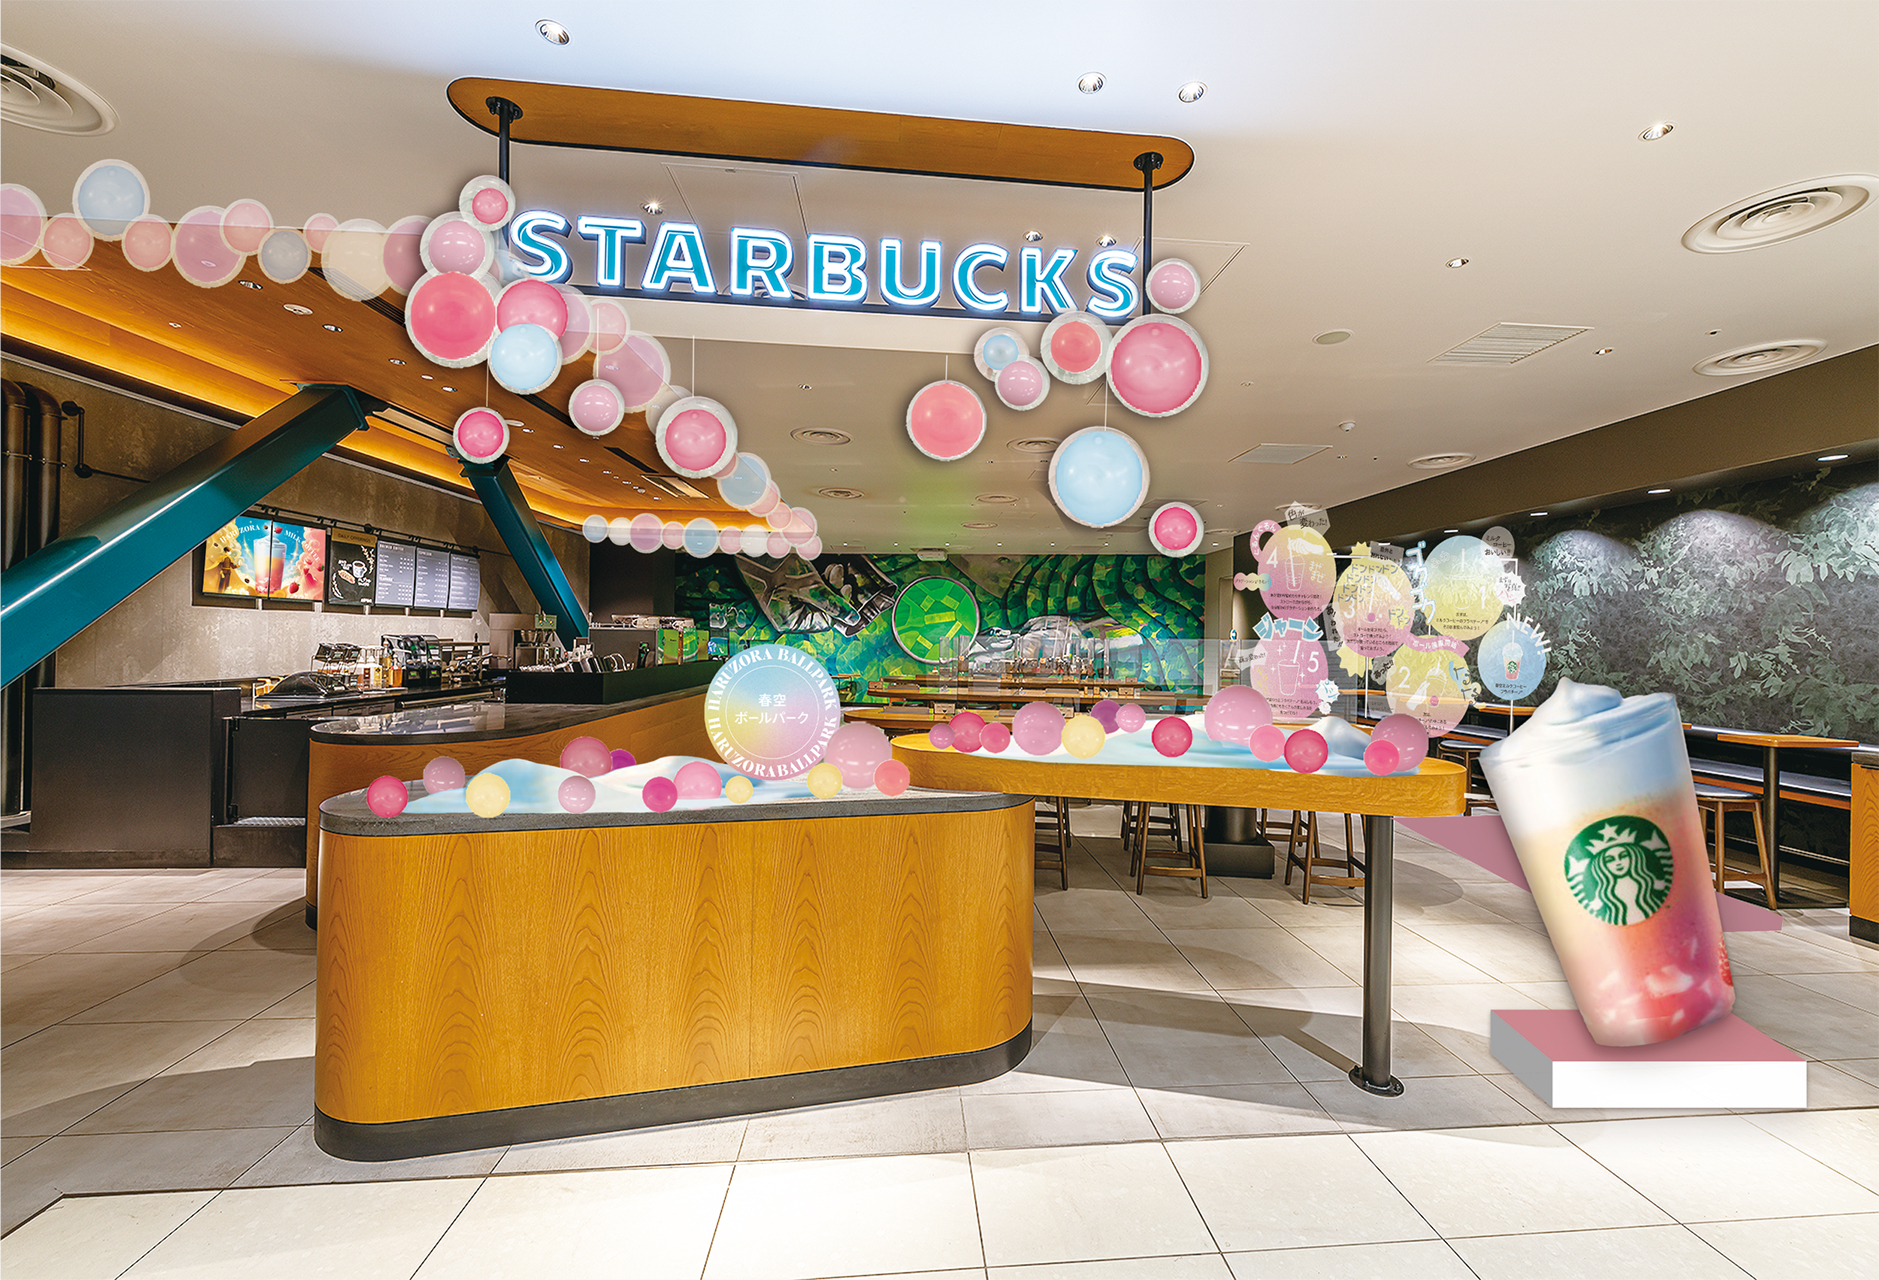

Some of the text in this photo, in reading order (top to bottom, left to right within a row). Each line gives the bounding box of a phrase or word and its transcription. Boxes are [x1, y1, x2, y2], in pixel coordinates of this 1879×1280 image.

[510, 207, 1140, 318] STARBUCKS
[219, 524, 261, 544] HARUZORA
[284, 529, 302, 544] MILK
[1266, 546, 1279, 568] 4
[1344, 597, 1355, 619] 3
[1479, 586, 1486, 609] 1
[1252, 612, 1325, 642] ジャーン
[1506, 612, 1552, 655] NEW!
[1307, 651, 1320, 673] 5
[708, 647, 838, 711] HARUZORA BALLPARK
[1398, 666, 1411, 688] 2
[758, 693, 787, 707] 春空
[734, 711, 809, 725] ボールパーク
